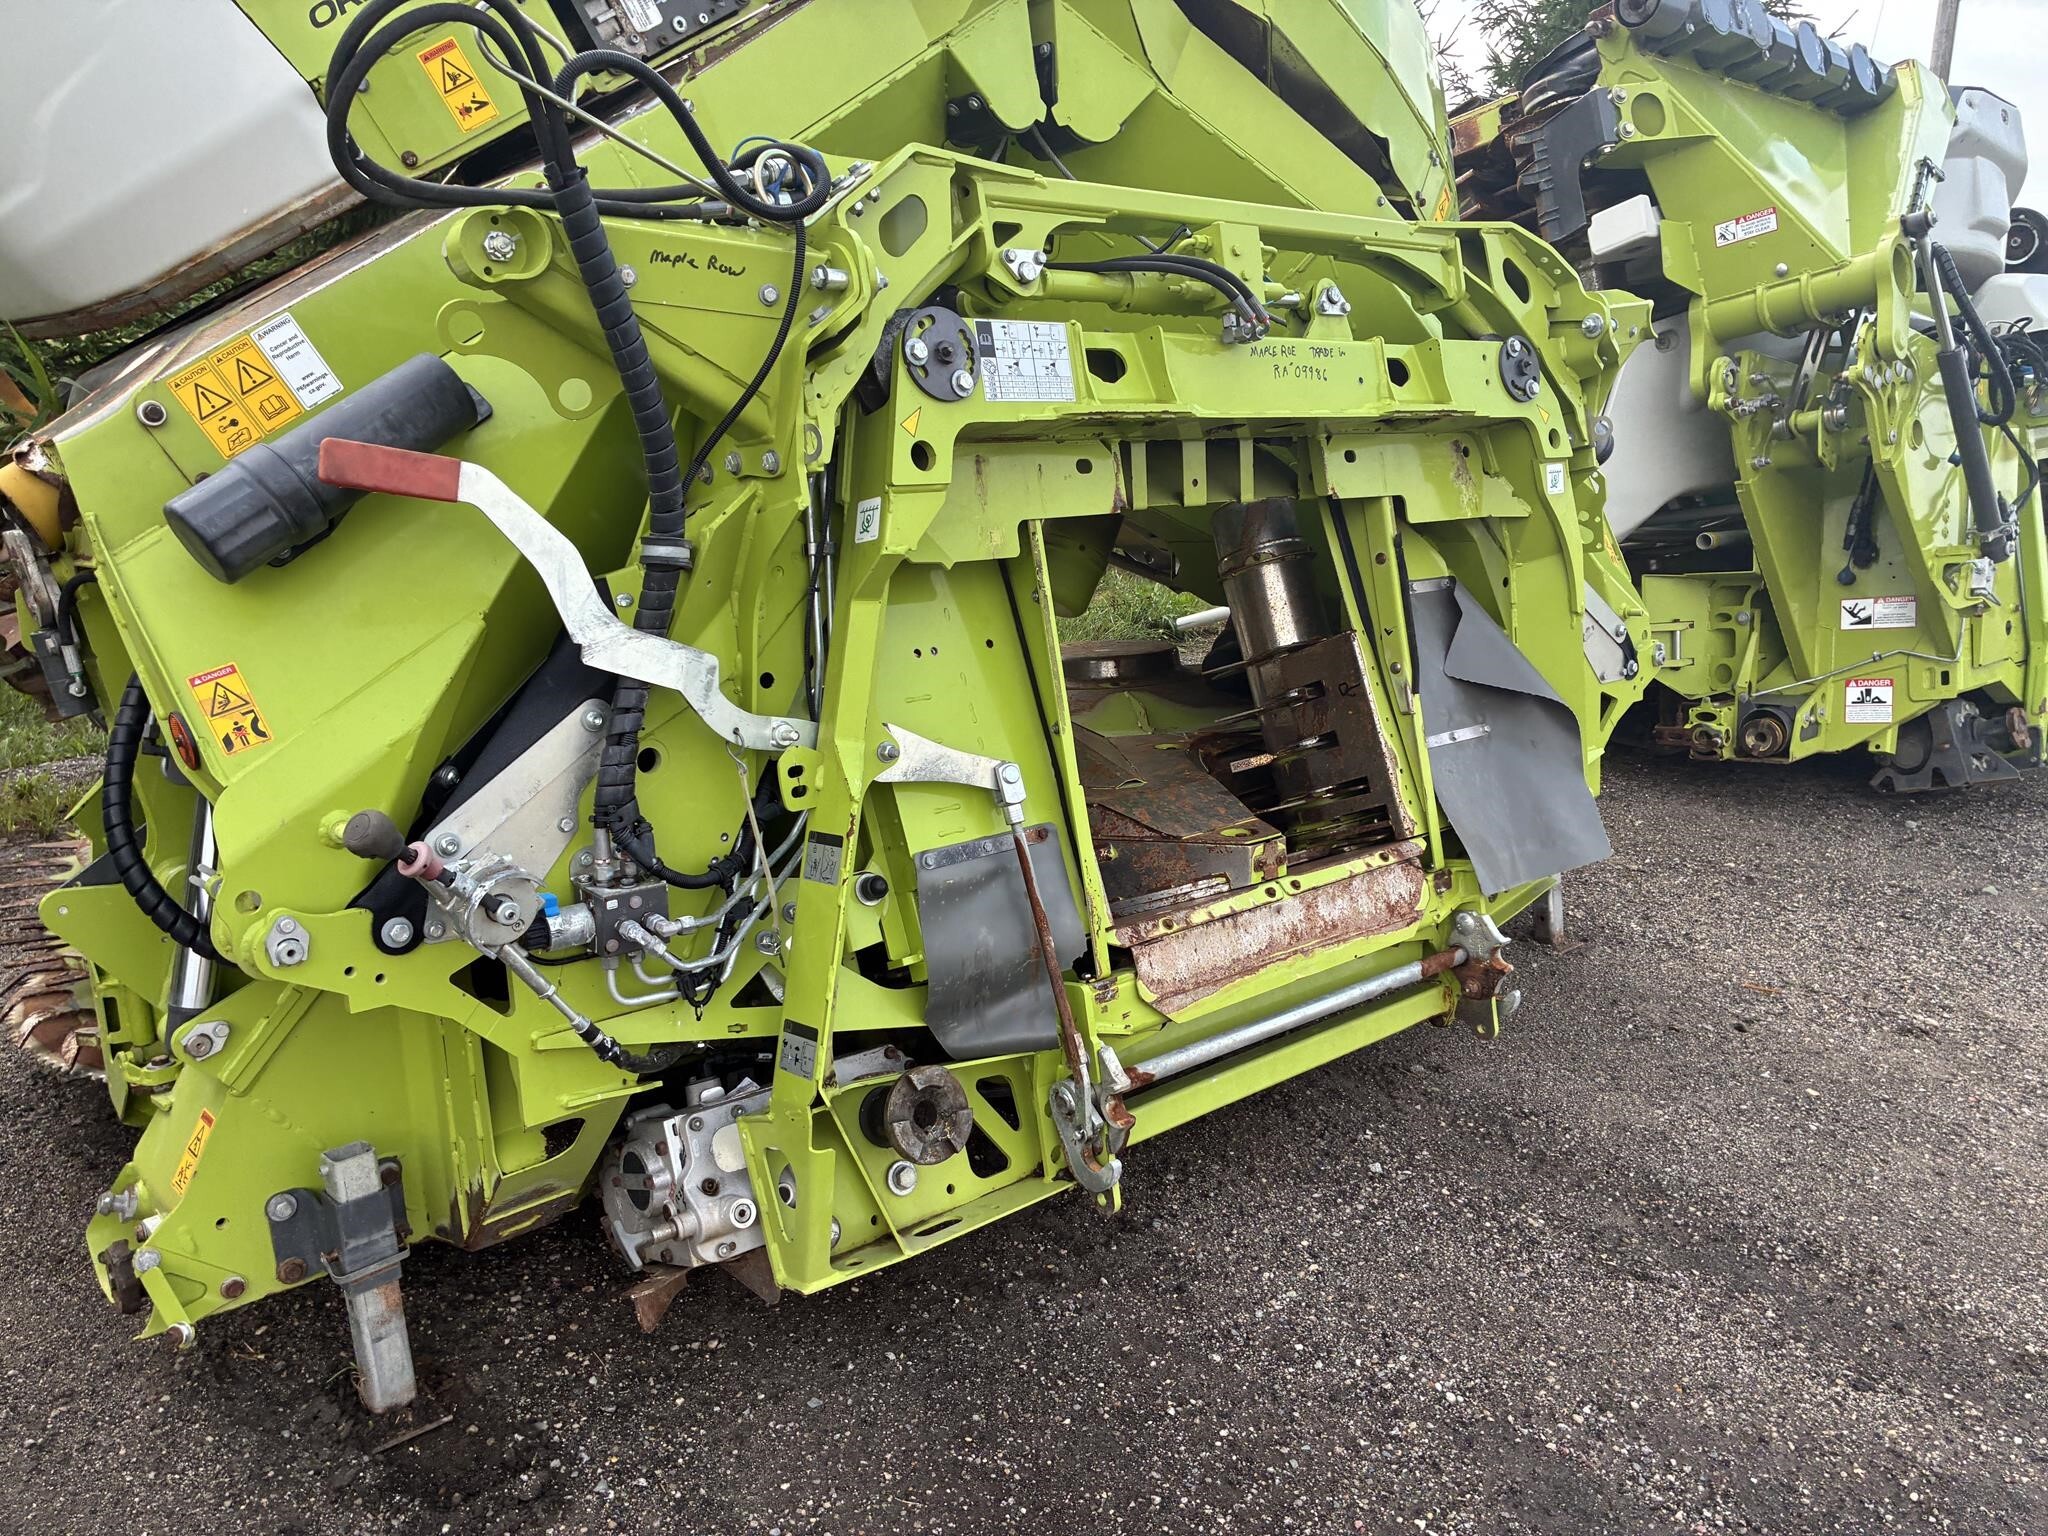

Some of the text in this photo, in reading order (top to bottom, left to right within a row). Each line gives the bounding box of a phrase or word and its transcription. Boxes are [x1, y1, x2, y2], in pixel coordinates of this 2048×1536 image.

[1746, 207, 1774, 221] DANGER
[649, 249, 746, 277] Maple Row
[263, 317, 291, 337] WARNING
[221, 341, 249, 360] CAUTION
[269, 333, 299, 353] Cancer and
[271, 339, 306, 360] Reproductive
[1250, 344, 1278, 358] MAPLE
[1309, 346, 1334, 359] TRADE
[285, 350, 301, 361] Harm
[179, 366, 208, 385] CAUTION
[201, 667, 233, 682] DANGER
[1858, 679, 1891, 687] DANGER
